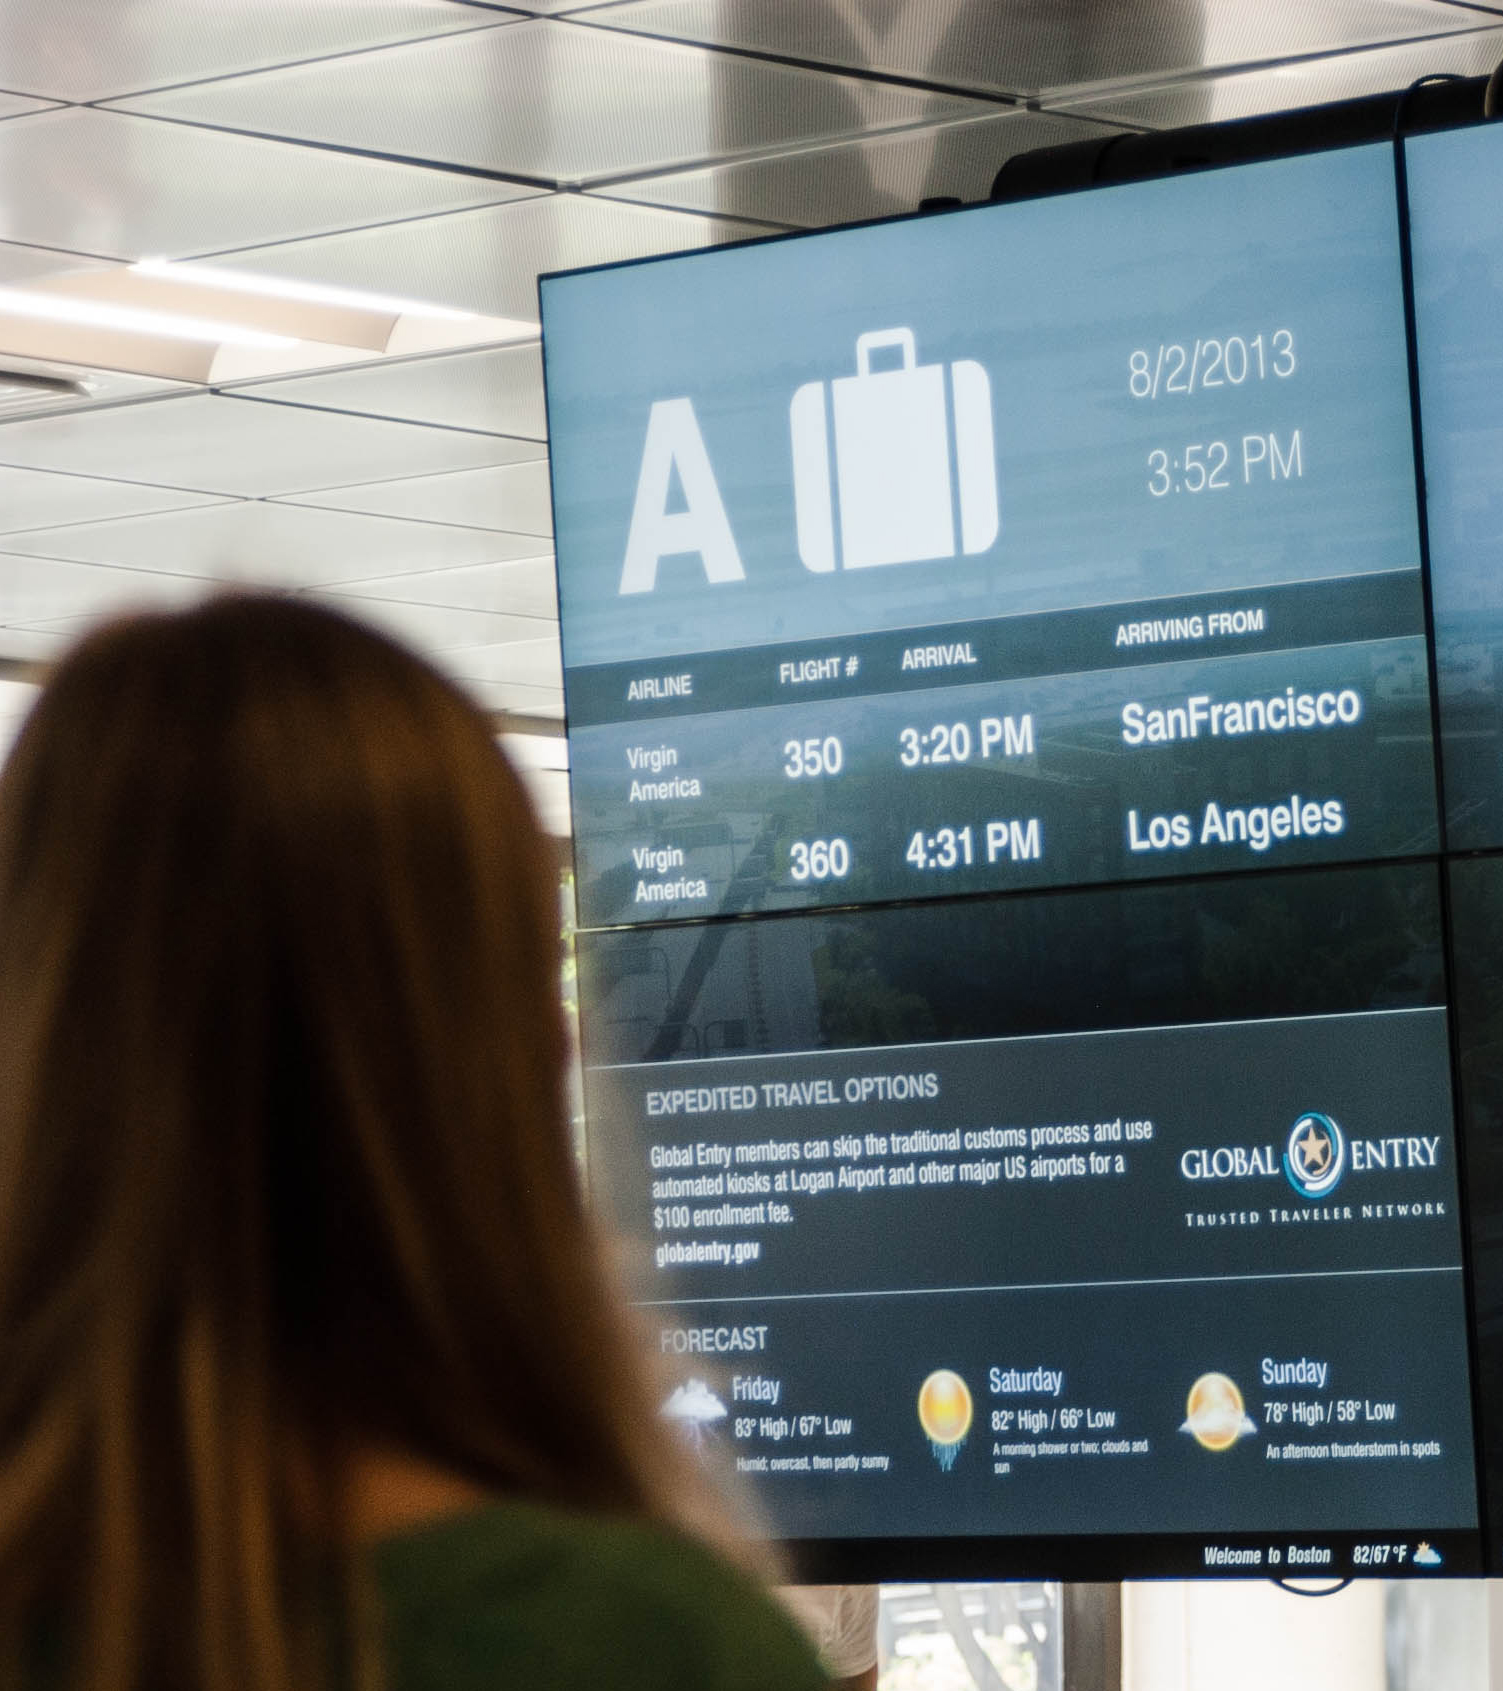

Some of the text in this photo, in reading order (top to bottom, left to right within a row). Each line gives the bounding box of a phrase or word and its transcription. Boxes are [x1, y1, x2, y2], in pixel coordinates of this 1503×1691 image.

[1129, 329, 1296, 400] 8/2/2013
[1148, 429, 1303, 496] 3:52 PM
[619, 397, 747, 595] A
[1116, 609, 1264, 647] ARRIVING FROM
[779, 656, 858, 683] FLIGHT #
[902, 643, 977, 670] ARRIVAL
[627, 674, 693, 701] AIRLINE
[900, 714, 1034, 767] 3:20 PM
[627, 744, 678, 773] Virgin
[784, 736, 843, 778] 350
[629, 776, 701, 802] America
[1128, 795, 1344, 851] Los Angeles
[633, 845, 684, 873] Virgin
[790, 838, 849, 880] 360
[906, 819, 1041, 869] 4:31 PM
[635, 877, 707, 902] America
[646, 1073, 939, 1115] EXPEDITED TRAVEL OPTIONS
[651, 1117, 1152, 1169] Global Entry members can skip the traditional customs process and use
[1181, 1136, 1441, 1180] GLOBAL ENTRY
[653, 1152, 1125, 1199] automated kiosks at Logan Airport and other major US airports for a
[654, 1200, 794, 1230] $100 enrollment fee.
[1185, 1202, 1446, 1227] TRUSTED TRAVELER NETWORK
[656, 1242, 760, 1268] globalentry.gov
[661, 1326, 768, 1353] FORECAST
[989, 1366, 1063, 1396] Saturday
[1262, 1357, 1327, 1388] Sunday
[732, 1375, 781, 1406] Friday
[760, 1417, 788, 1441] High
[825, 1415, 852, 1435] Low
[1018, 1409, 1048, 1434] High
[1087, 1407, 1116, 1428] Low
[1292, 1401, 1323, 1427] High
[1365, 1400, 1396, 1421] Low
[1266, 1440, 1440, 1459] An afternoon thunderstorm in spots
[1204, 1546, 1262, 1565] Welcome
[1268, 1547, 1281, 1564] to
[1288, 1546, 1331, 1564] Boston
[1353, 1545, 1390, 1565] 82/67
